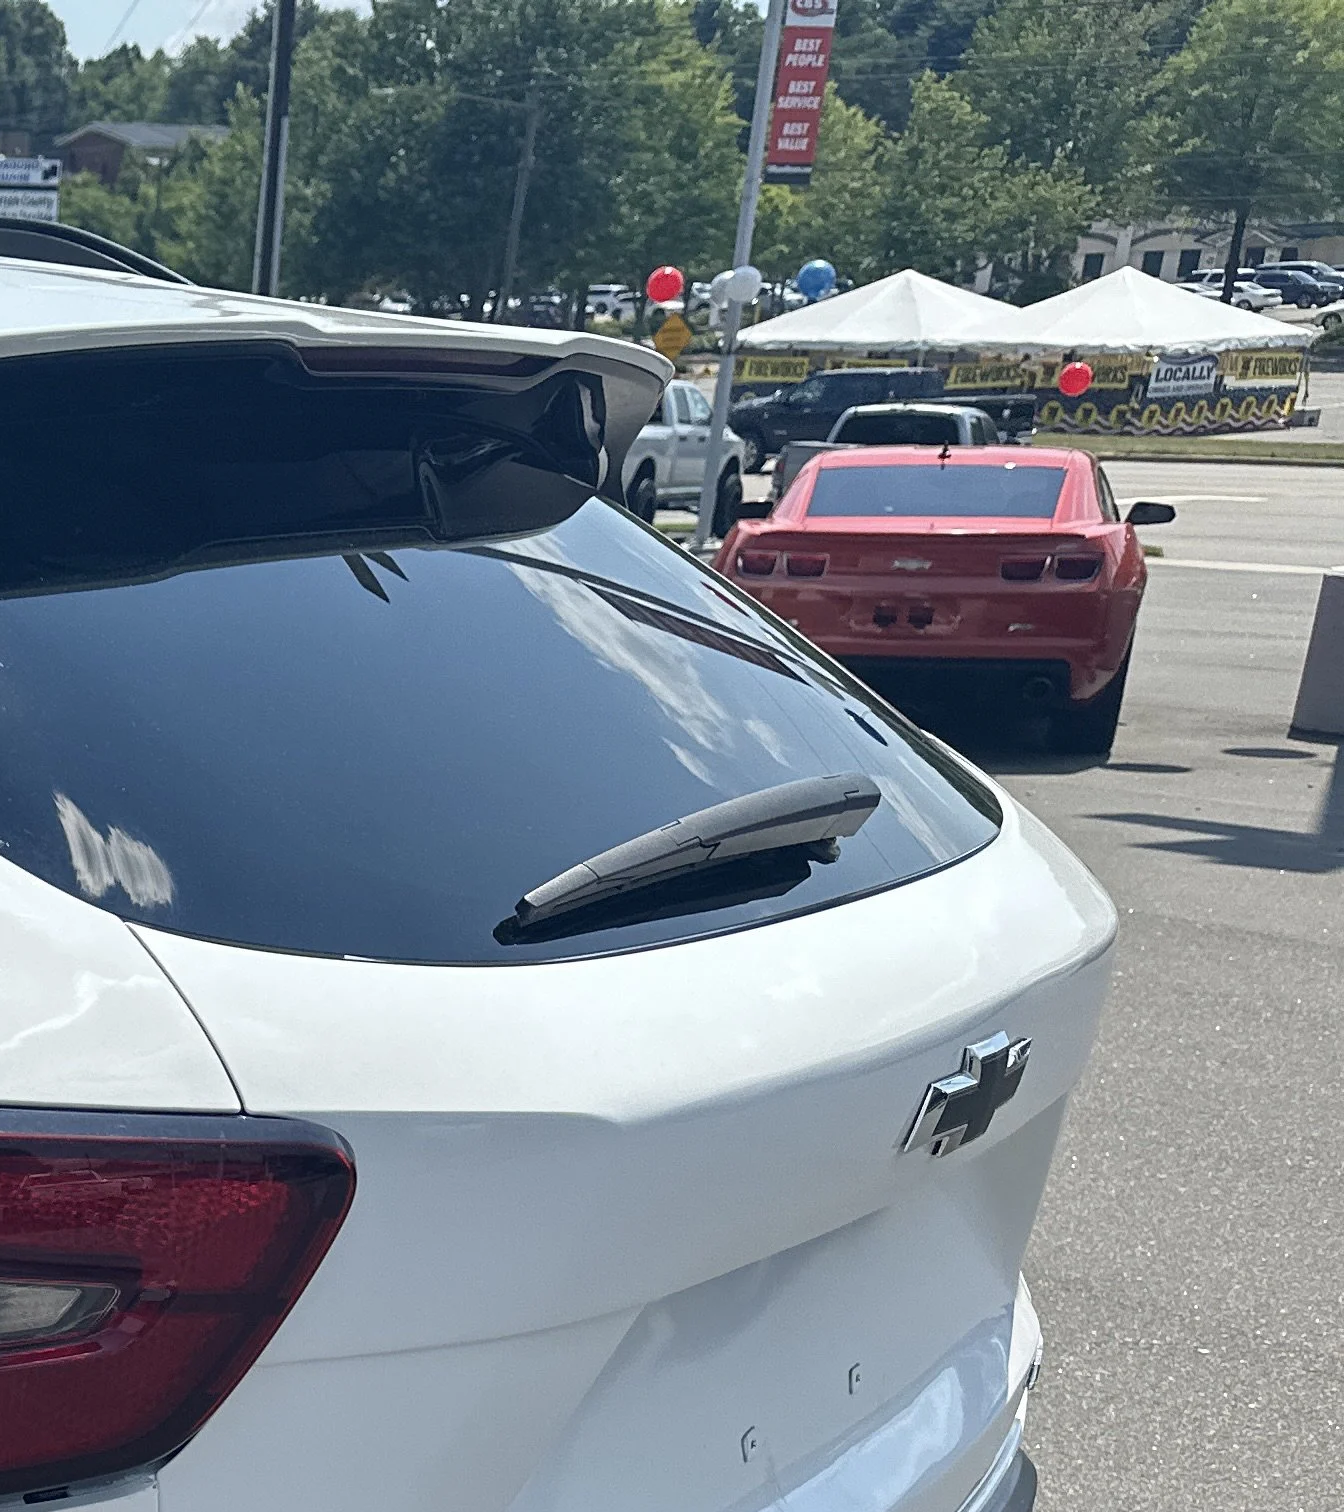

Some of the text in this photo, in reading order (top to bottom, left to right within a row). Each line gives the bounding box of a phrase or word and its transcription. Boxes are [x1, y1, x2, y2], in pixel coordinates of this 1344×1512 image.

[794, 38, 823, 52] BEST
[785, 54, 825, 67] PEOPLE
[788, 81, 817, 94] BEST
[777, 96, 821, 110] SERVICE
[782, 122, 810, 136] BEST
[1154, 365, 1213, 383] LOCALLY
